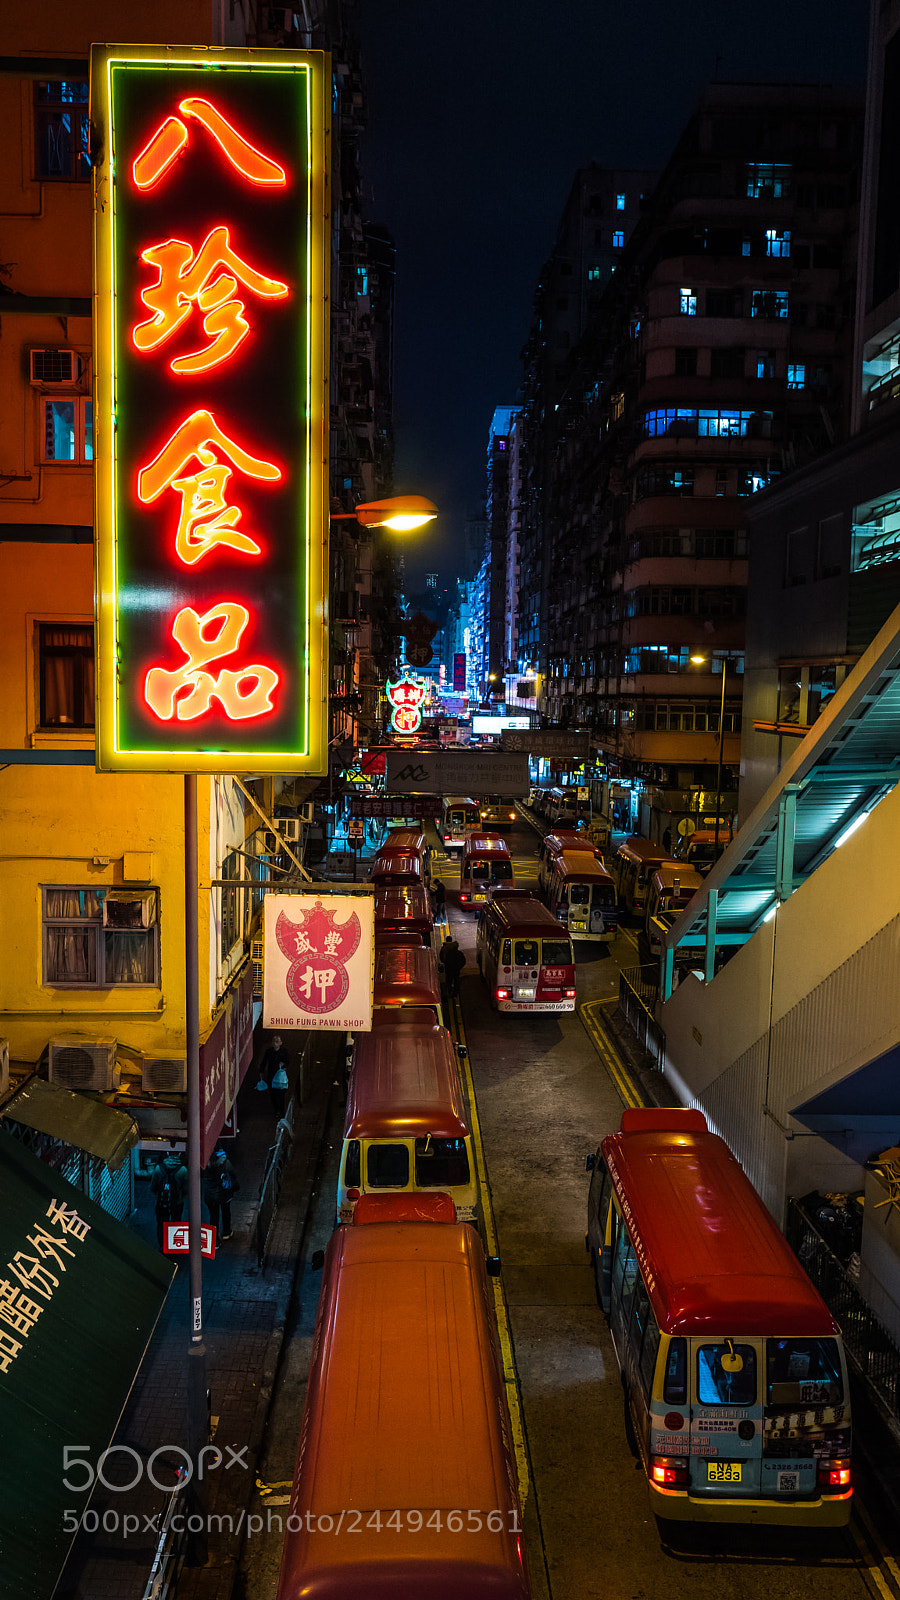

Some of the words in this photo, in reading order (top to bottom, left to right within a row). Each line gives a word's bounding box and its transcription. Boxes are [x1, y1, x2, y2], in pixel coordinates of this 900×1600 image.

[131, 96, 290, 723] 八珍食品
[396, 708, 416, 731] 押
[298, 965, 337, 1004] 押
[270, 1017, 294, 1026] SHING
[296, 1018, 317, 1026] FUNG
[319, 1018, 341, 1027] PAWN
[343, 1019, 364, 1028] SHOP
[709, 1471, 741, 1481] 6233
[716, 1463, 733, 1472] NA
